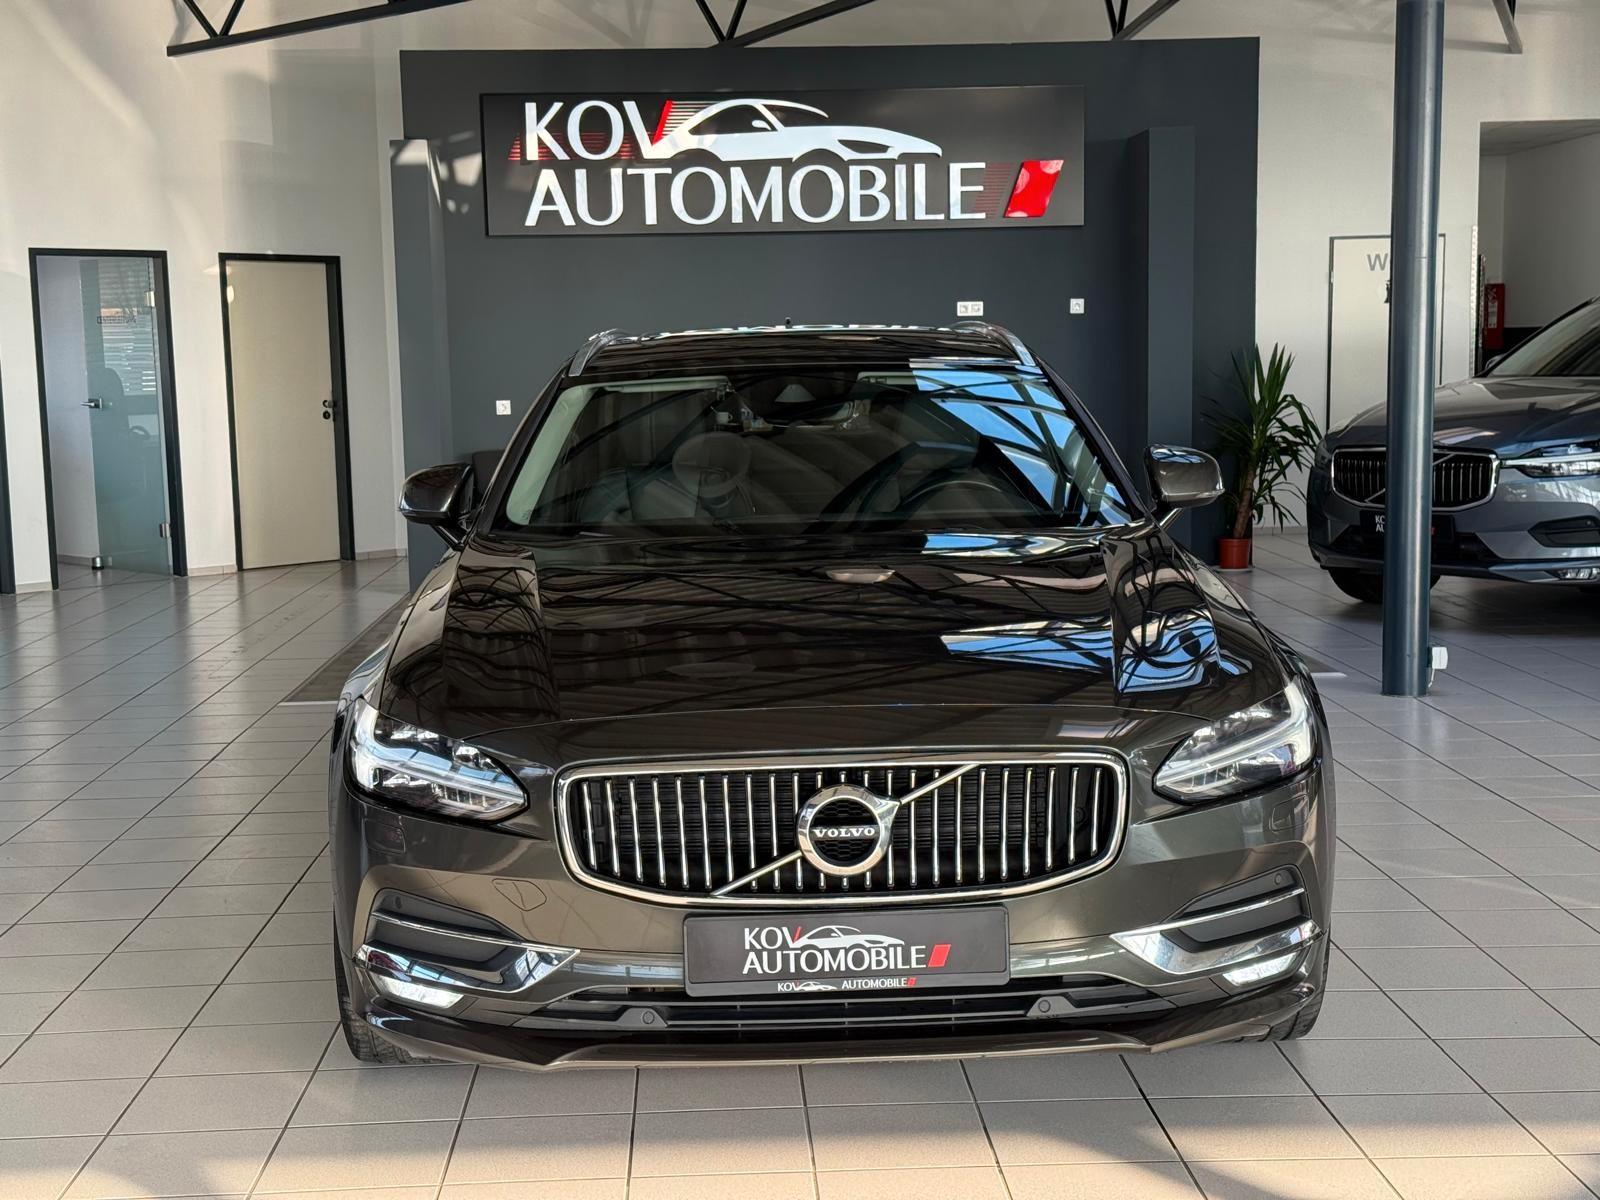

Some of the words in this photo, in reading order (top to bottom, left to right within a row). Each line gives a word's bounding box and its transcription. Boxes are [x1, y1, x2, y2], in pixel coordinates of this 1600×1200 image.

[523, 100, 675, 160] KOV
[524, 162, 986, 227] AUTOMOBILE
[1366, 253, 1388, 271] W
[812, 827, 875, 838] VOLVO
[744, 926, 801, 949] KOV
[742, 945, 926, 974] AUTOMOBILE
[777, 982, 800, 992] KOV
[841, 978, 907, 989] AUTOMOBILE
